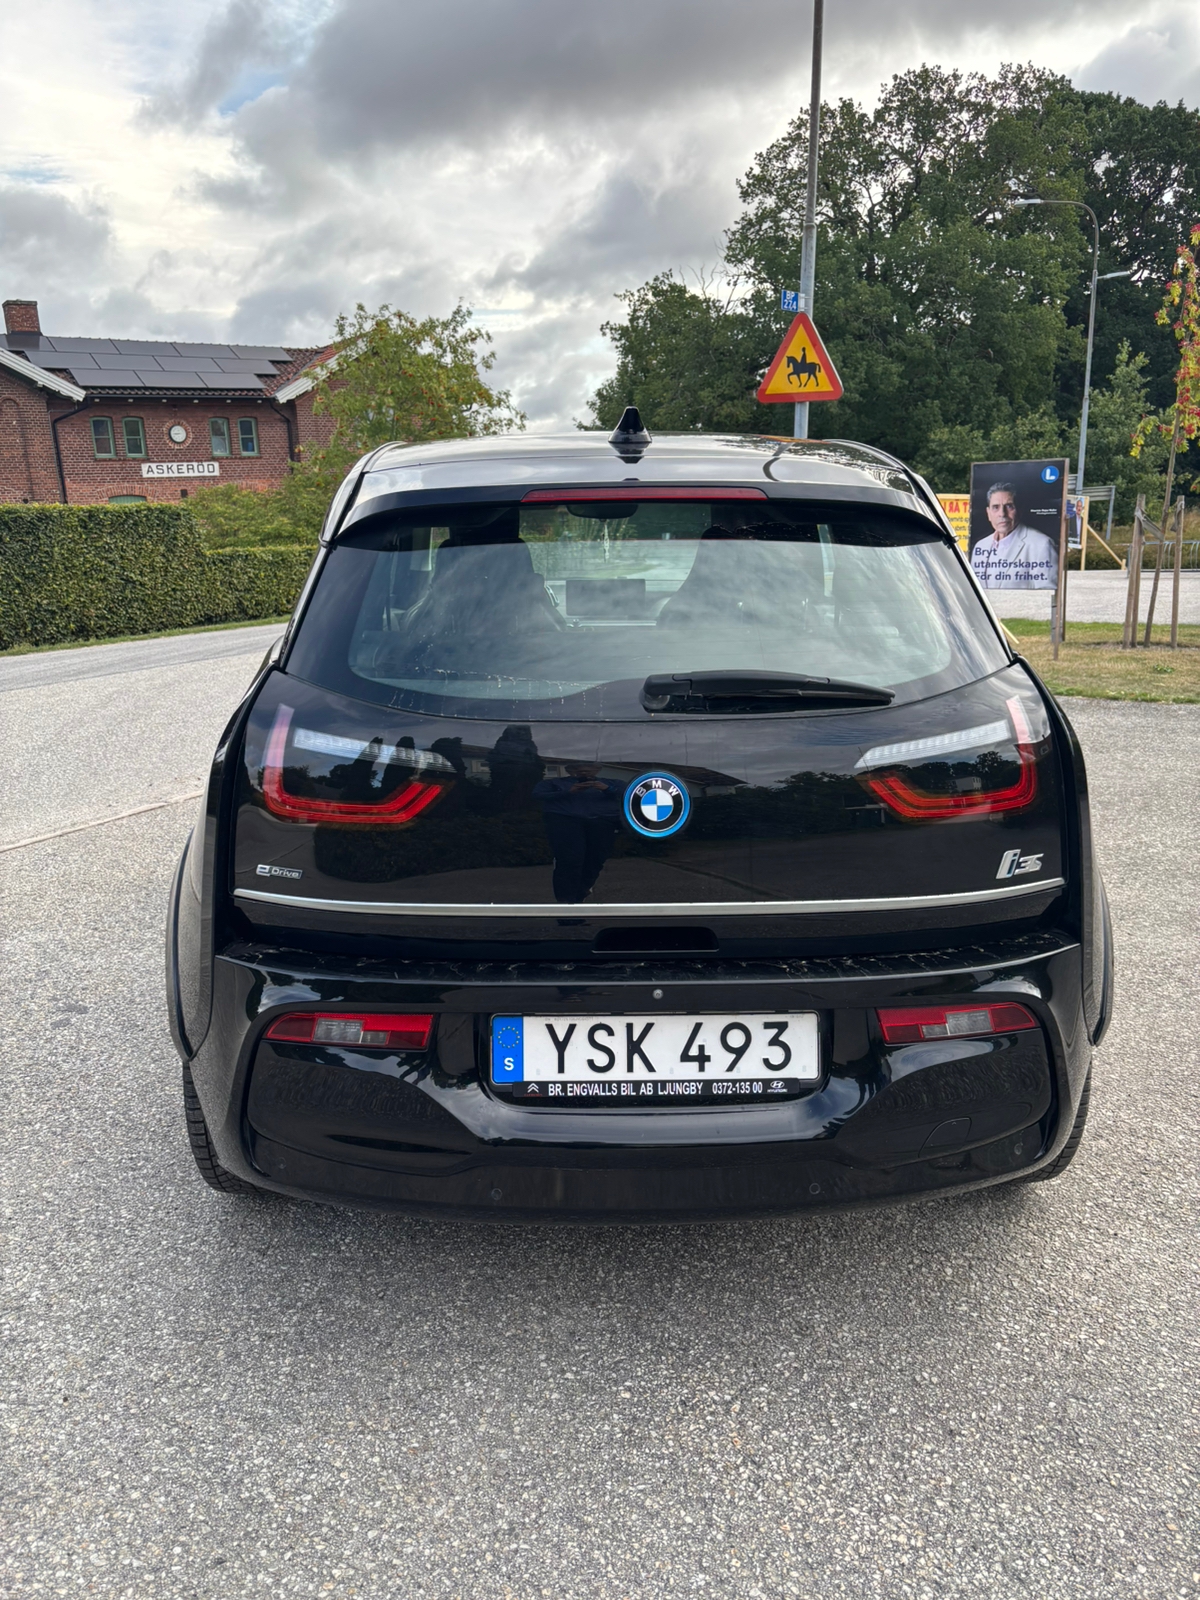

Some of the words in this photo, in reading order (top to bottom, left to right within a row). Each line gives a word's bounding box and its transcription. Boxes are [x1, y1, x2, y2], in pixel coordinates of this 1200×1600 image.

[783, 299, 797, 310] 274
[146, 462, 216, 475] ASKERÖD
[974, 547, 998, 559] Bryt
[974, 559, 1053, 570] utanförskapet.
[974, 571, 992, 580] För
[995, 571, 1011, 580] din
[1015, 571, 1048, 580] frihet.
[636, 779, 679, 797] BMW
[545, 1022, 656, 1074] YSK
[680, 1021, 792, 1072] 493
[504, 1057, 515, 1071] S
[548, 1083, 565, 1096] BR.
[567, 1083, 618, 1096] ENGVALLS
[620, 1083, 636, 1096] BIL
[639, 1083, 654, 1095] AB
[658, 1082, 703, 1095] LJUNGBY
[712, 1082, 750, 1094] 0372-135
[752, 1081, 763, 1093] 00
